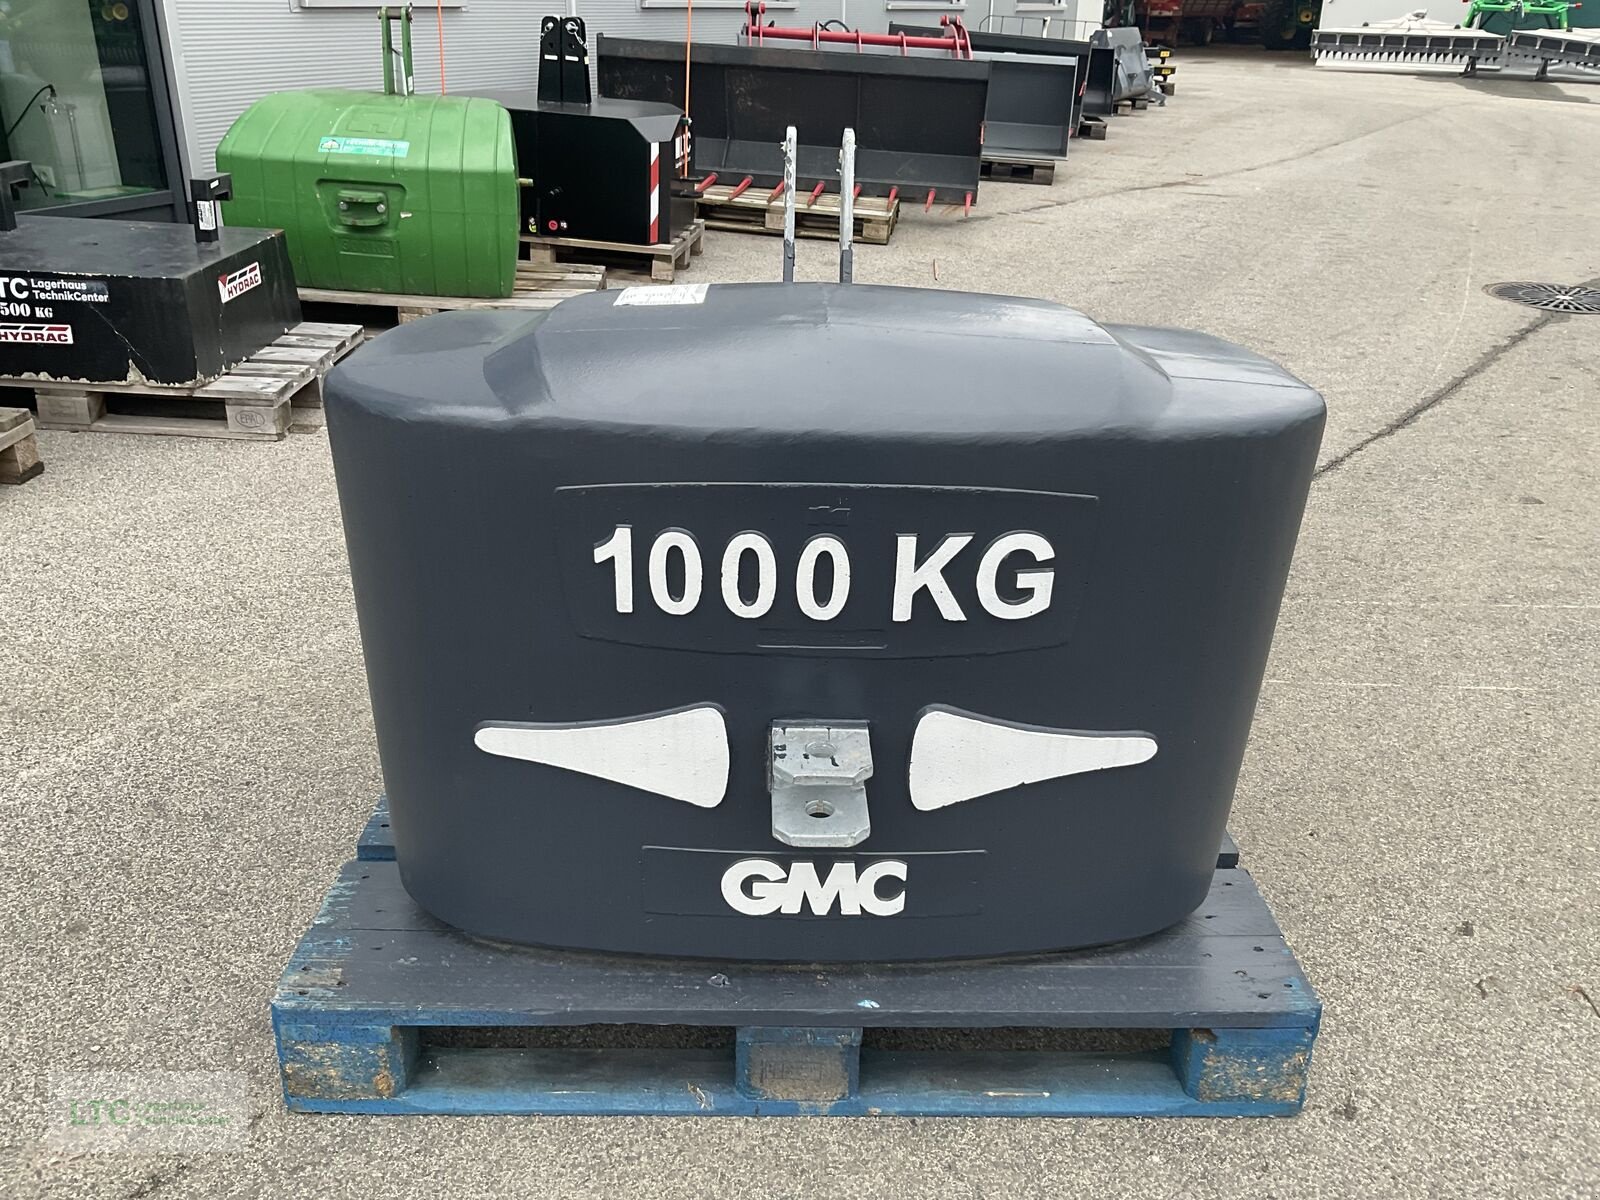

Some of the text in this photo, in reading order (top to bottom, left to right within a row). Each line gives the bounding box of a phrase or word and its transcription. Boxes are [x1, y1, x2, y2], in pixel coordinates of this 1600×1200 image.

[30, 278, 87, 291] Lagerhaus
[227, 273, 259, 298] HYDRAC
[32, 289, 109, 302] TechnikCenter
[34, 306, 54, 318] KG
[0, 331, 69, 342] HYDRAC
[593, 524, 1056, 622] 1000 KG
[721, 858, 908, 916] GMC
